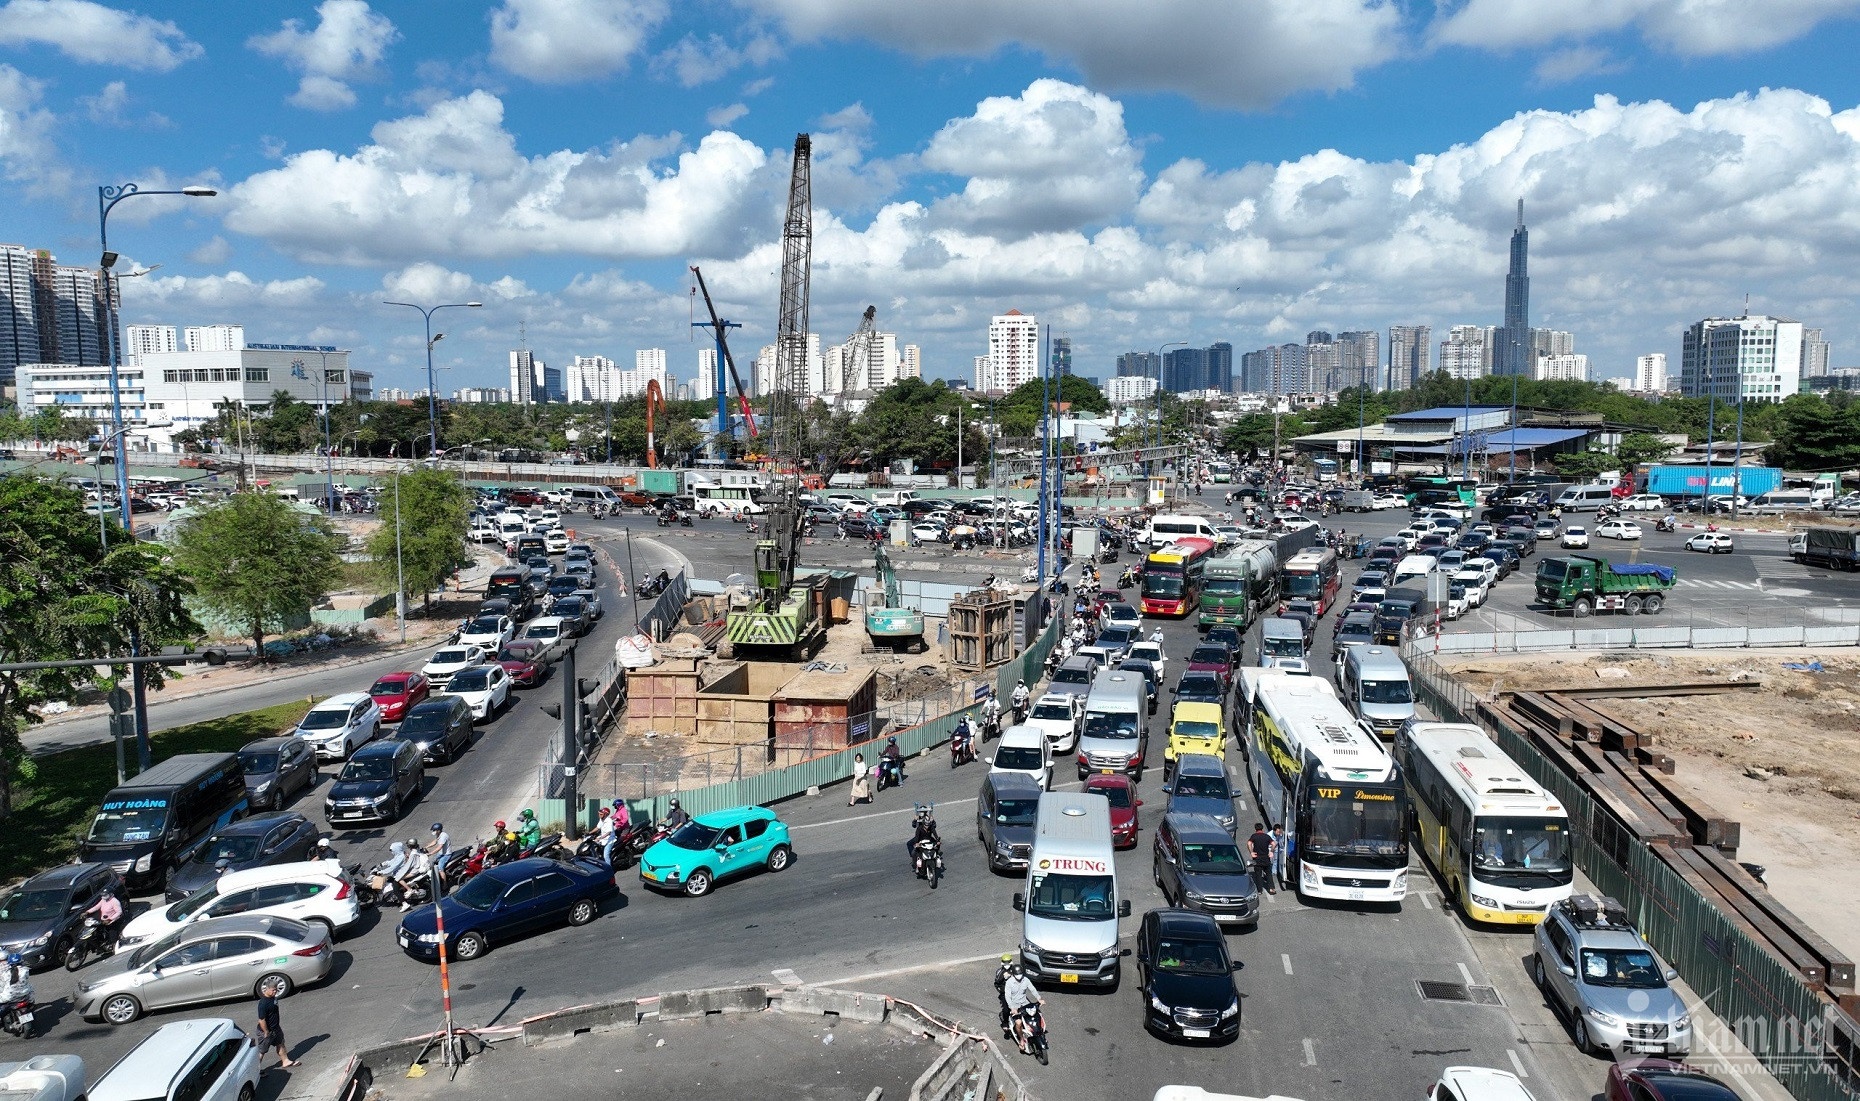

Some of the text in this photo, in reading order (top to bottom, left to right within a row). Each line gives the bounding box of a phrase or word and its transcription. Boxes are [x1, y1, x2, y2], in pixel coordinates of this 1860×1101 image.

[1317, 788, 1341, 799] VIP
[1354, 789, 1395, 801] Limousine
[103, 798, 167, 811] HUY HOÀNG
[1052, 859, 1106, 872] TRUNG
